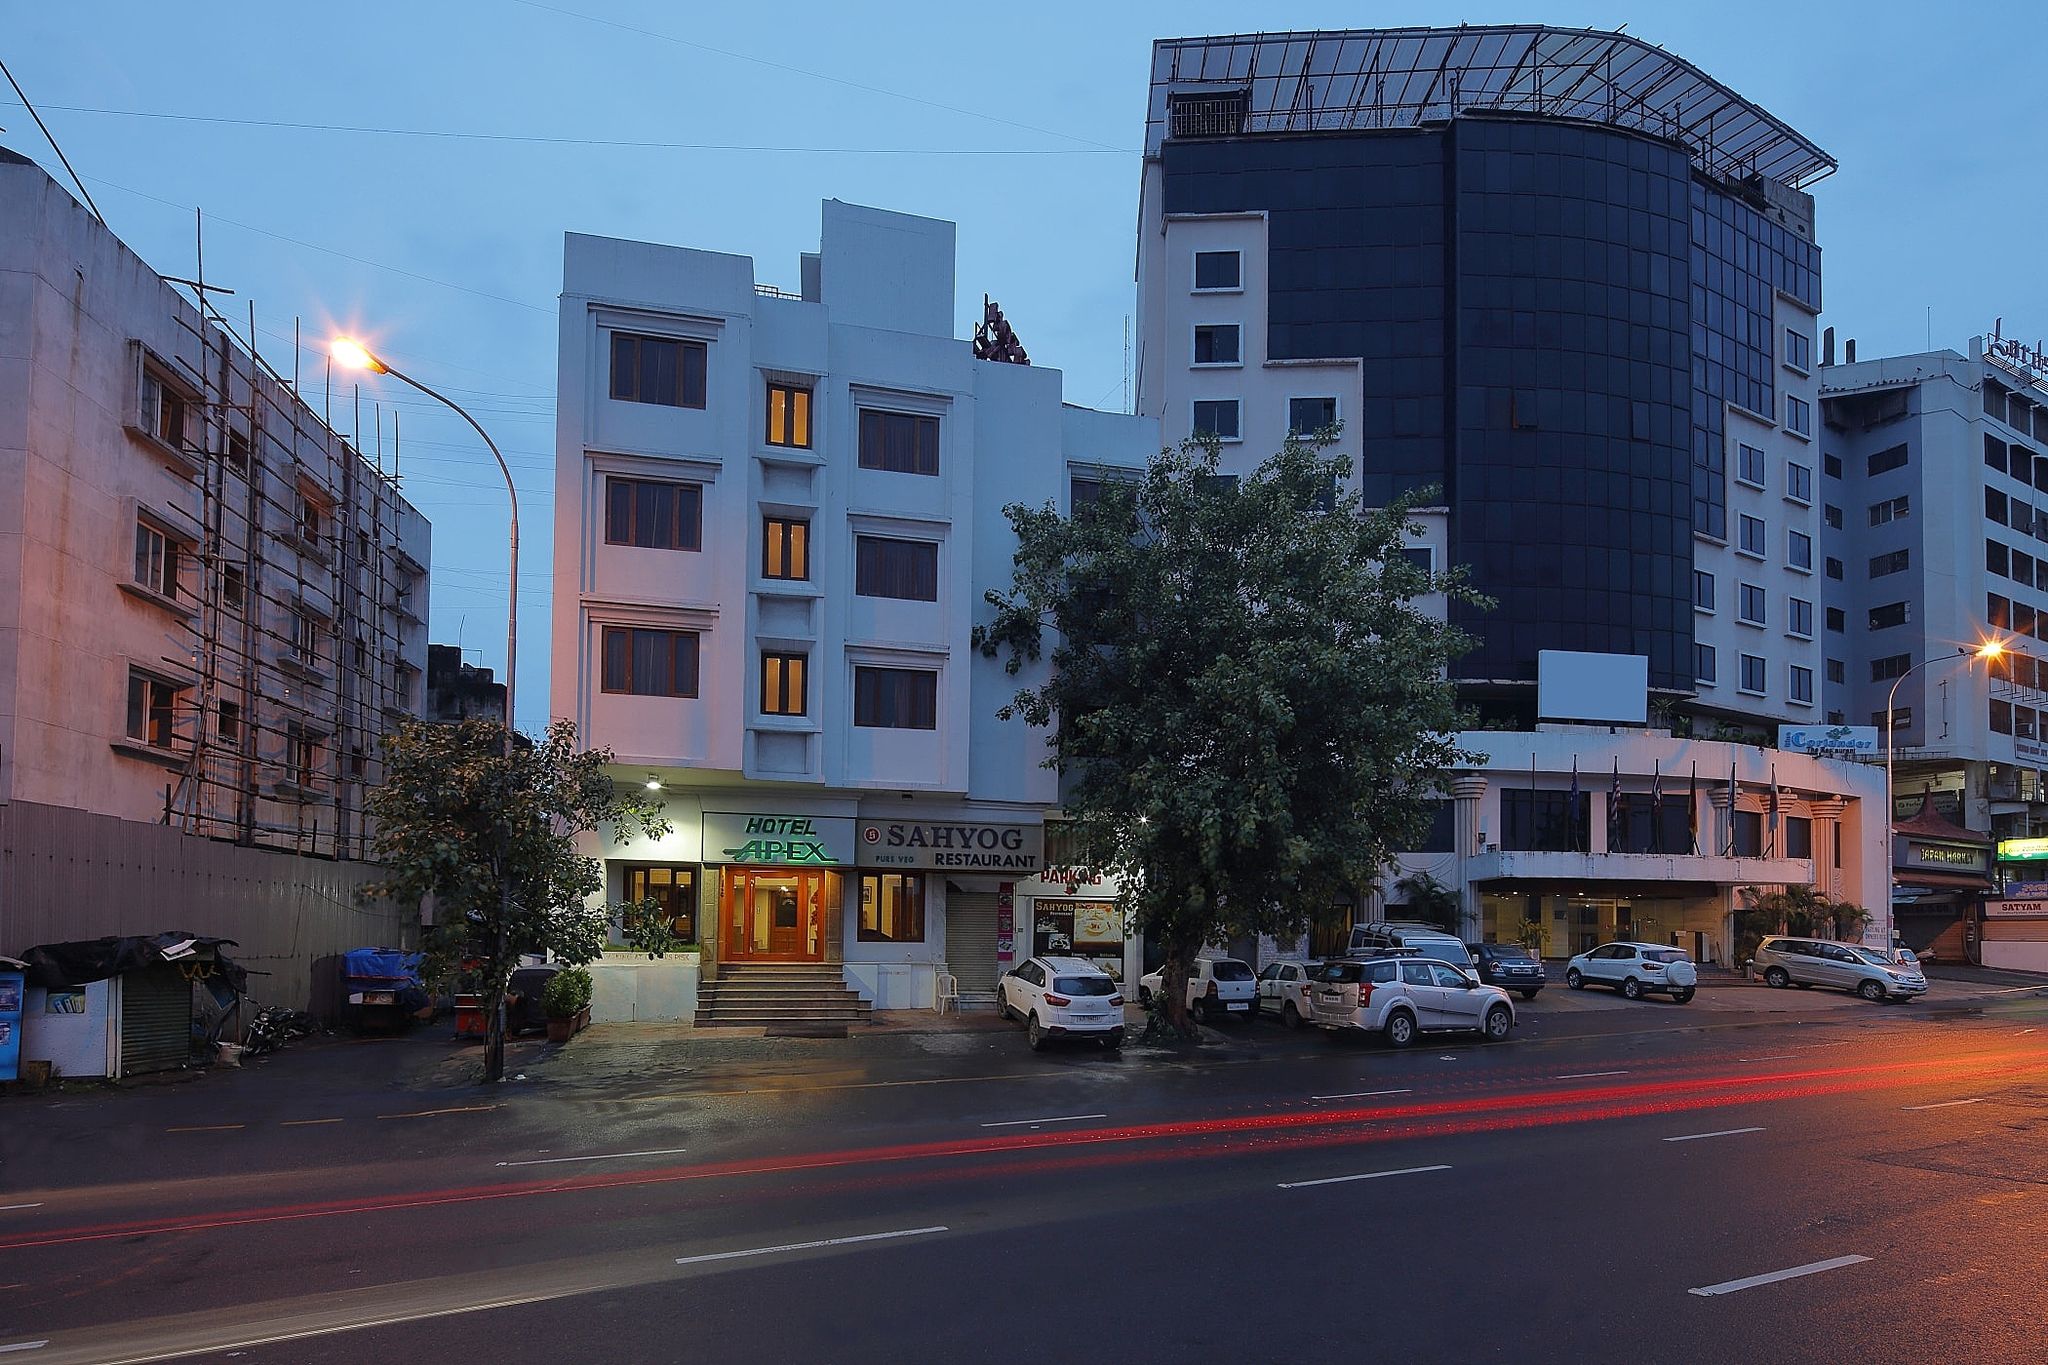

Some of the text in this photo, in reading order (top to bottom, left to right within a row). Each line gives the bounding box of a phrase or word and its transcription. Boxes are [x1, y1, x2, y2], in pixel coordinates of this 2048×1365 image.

[745, 817, 817, 836] HOTEL
[887, 825, 1024, 850] SAHYOG
[722, 840, 839, 862] APEX
[1920, 848, 1944, 863] JAPAN
[875, 855, 914, 864] PURE VEG
[934, 852, 1036, 868] RESTAURANT
[1035, 901, 1074, 912] SAHYOG
[2001, 903, 2042, 912] SATYAM
